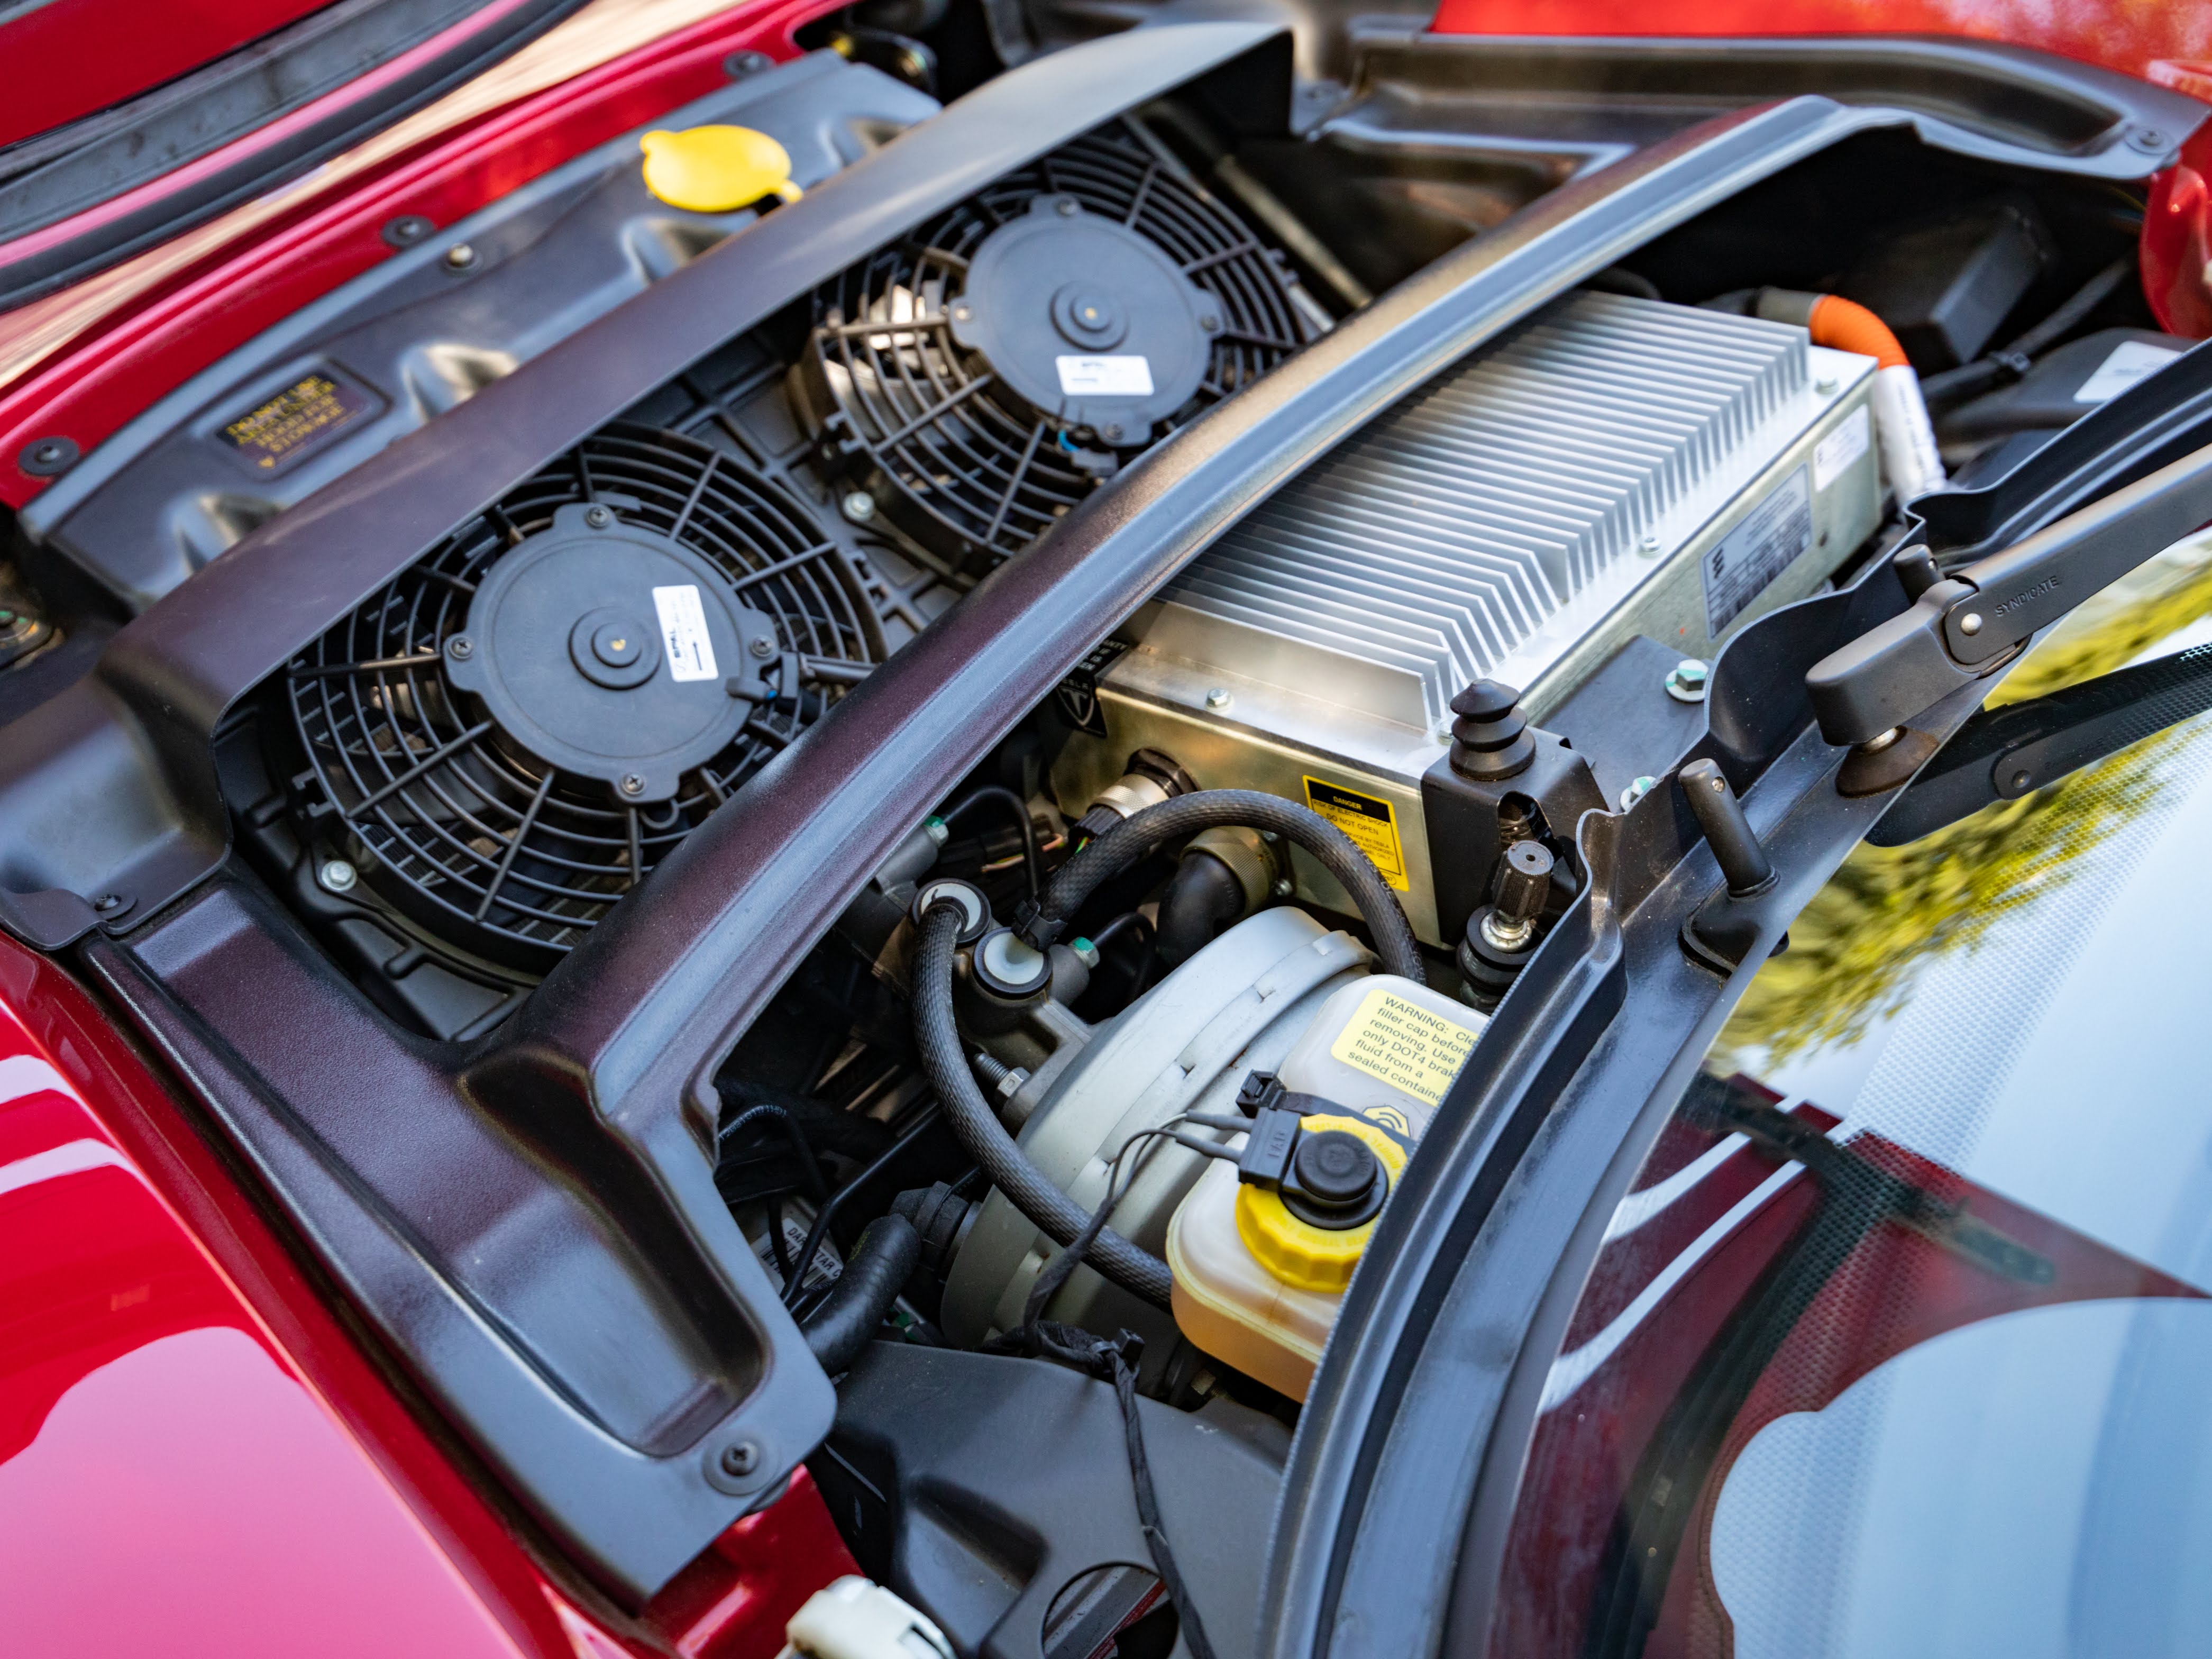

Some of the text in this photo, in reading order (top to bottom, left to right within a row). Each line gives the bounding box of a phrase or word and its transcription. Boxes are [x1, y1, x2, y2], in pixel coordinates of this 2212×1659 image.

[1995, 576, 2059, 617] SYNDICATE
[1332, 796, 1363, 811] DANGER
[1338, 807, 1366, 821] ELECTRIC
[1367, 817, 1388, 827] SHOCK
[1327, 813, 1379, 835] DO NOT OPEN
[1377, 1007, 1470, 1056] filler cap before
[1385, 997, 1449, 1033] WARNING:
[1355, 1039, 1424, 1079] fluid from a
[1363, 1029, 1389, 1046] only
[1391, 1042, 1427, 1064] DOT4
[1369, 1019, 1456, 1064] removing. Use
[1347, 1051, 1443, 1102] sealed containe
